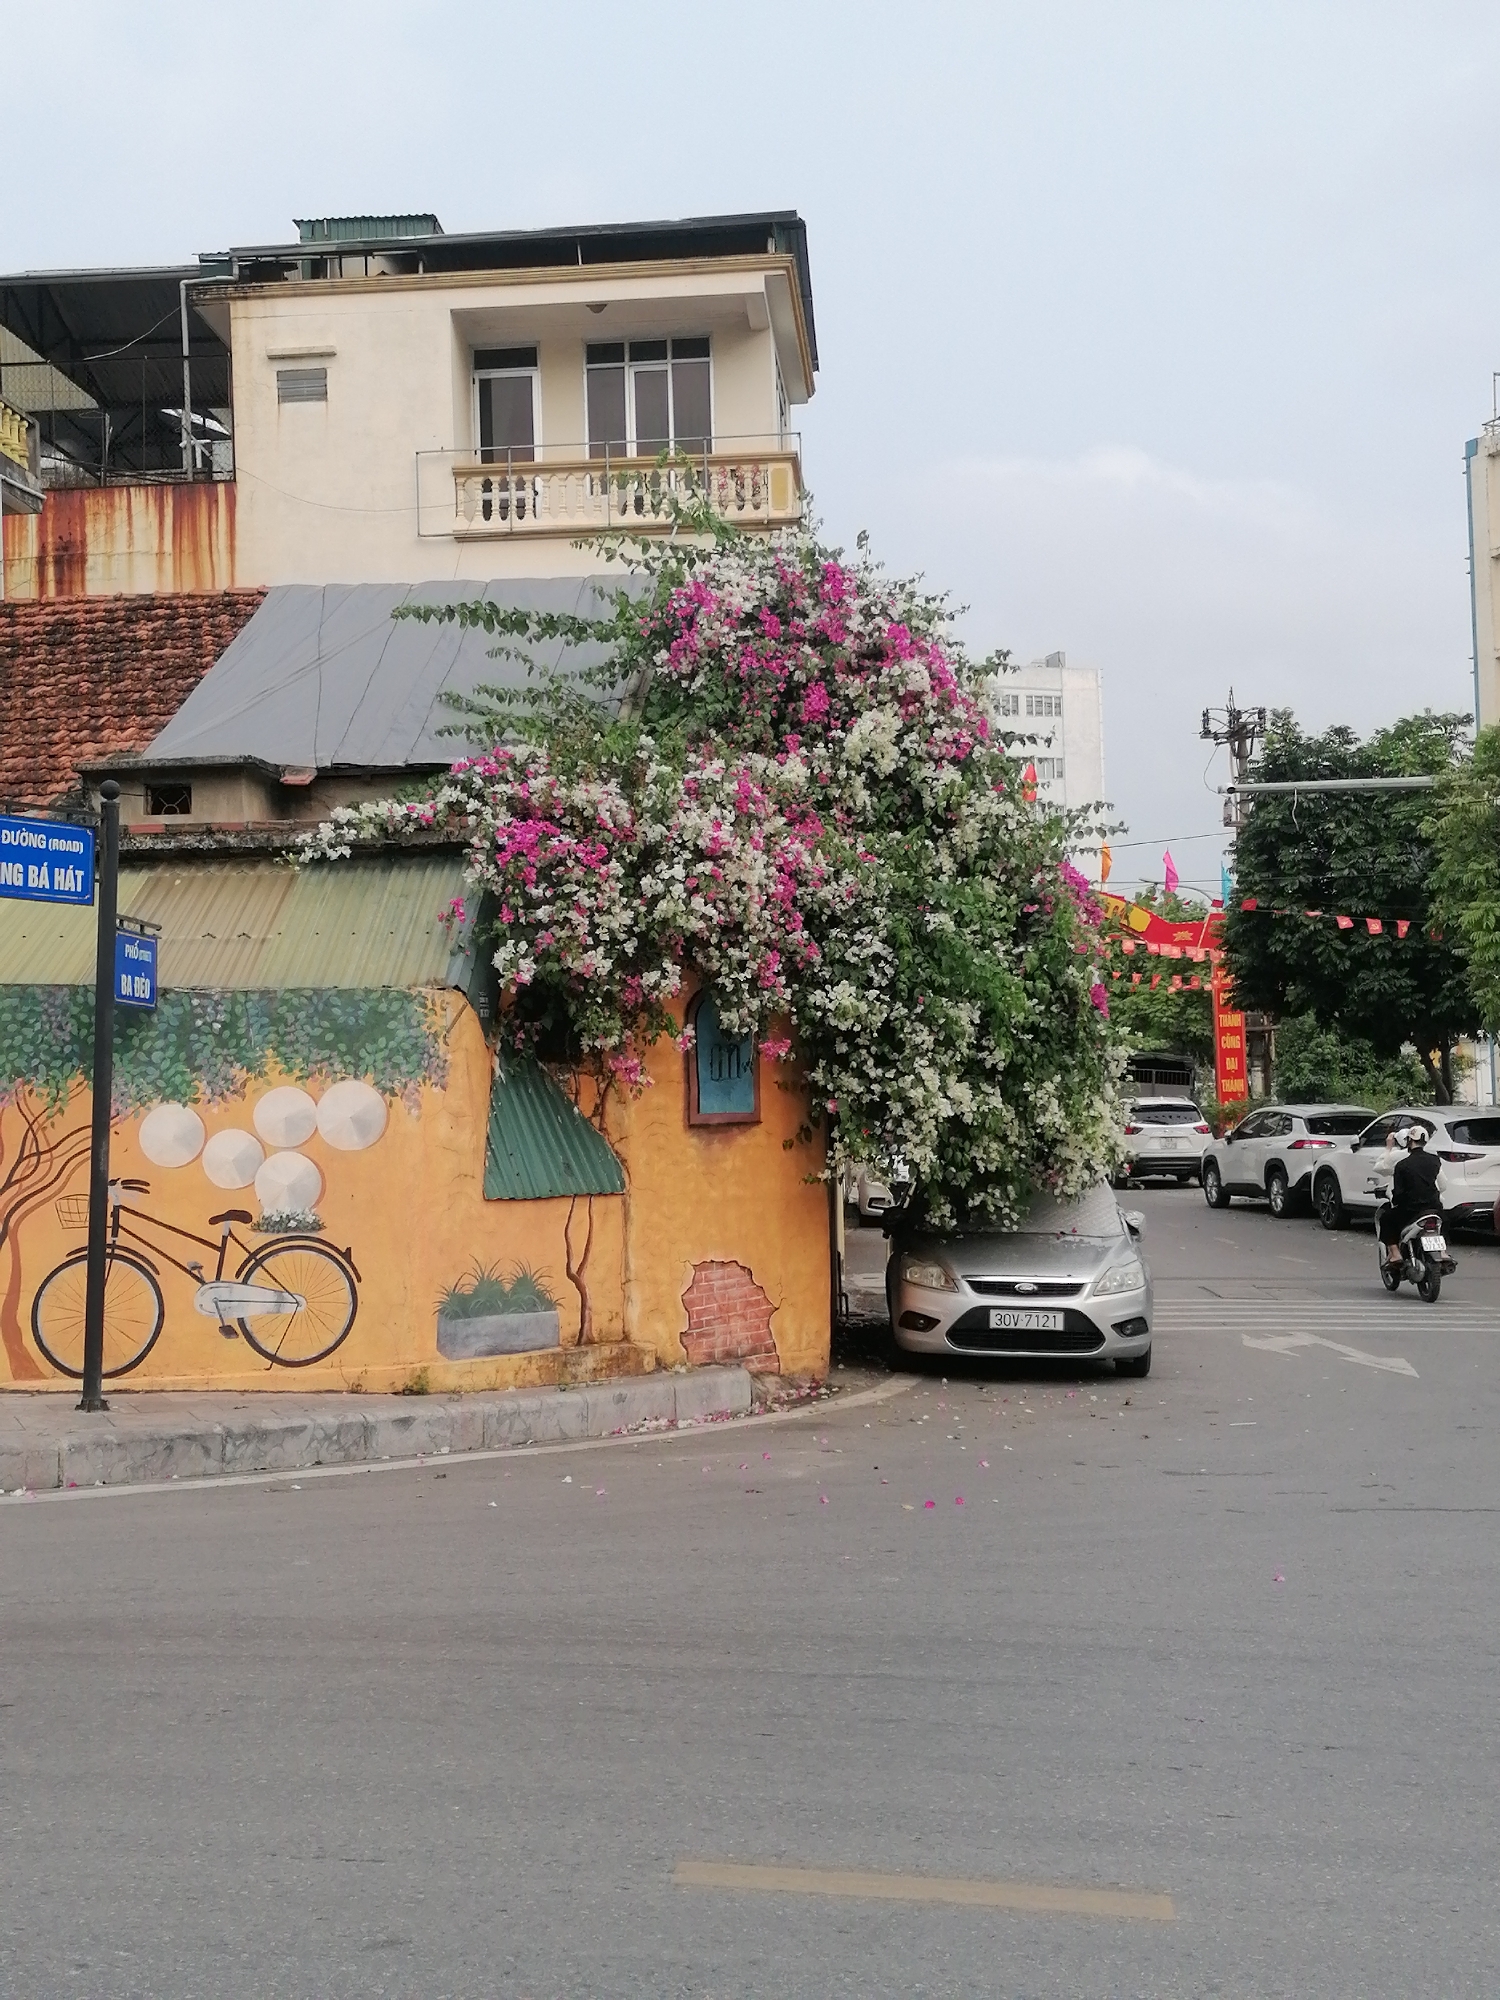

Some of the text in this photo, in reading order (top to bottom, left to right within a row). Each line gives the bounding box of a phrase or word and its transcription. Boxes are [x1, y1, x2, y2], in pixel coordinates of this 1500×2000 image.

[1, 827, 84, 854] ĐƯỜNG (ROAD)
[0, 861, 85, 892] NG BÁ HÁT
[124, 940, 139, 960] PHỐ
[121, 973, 133, 997] BA
